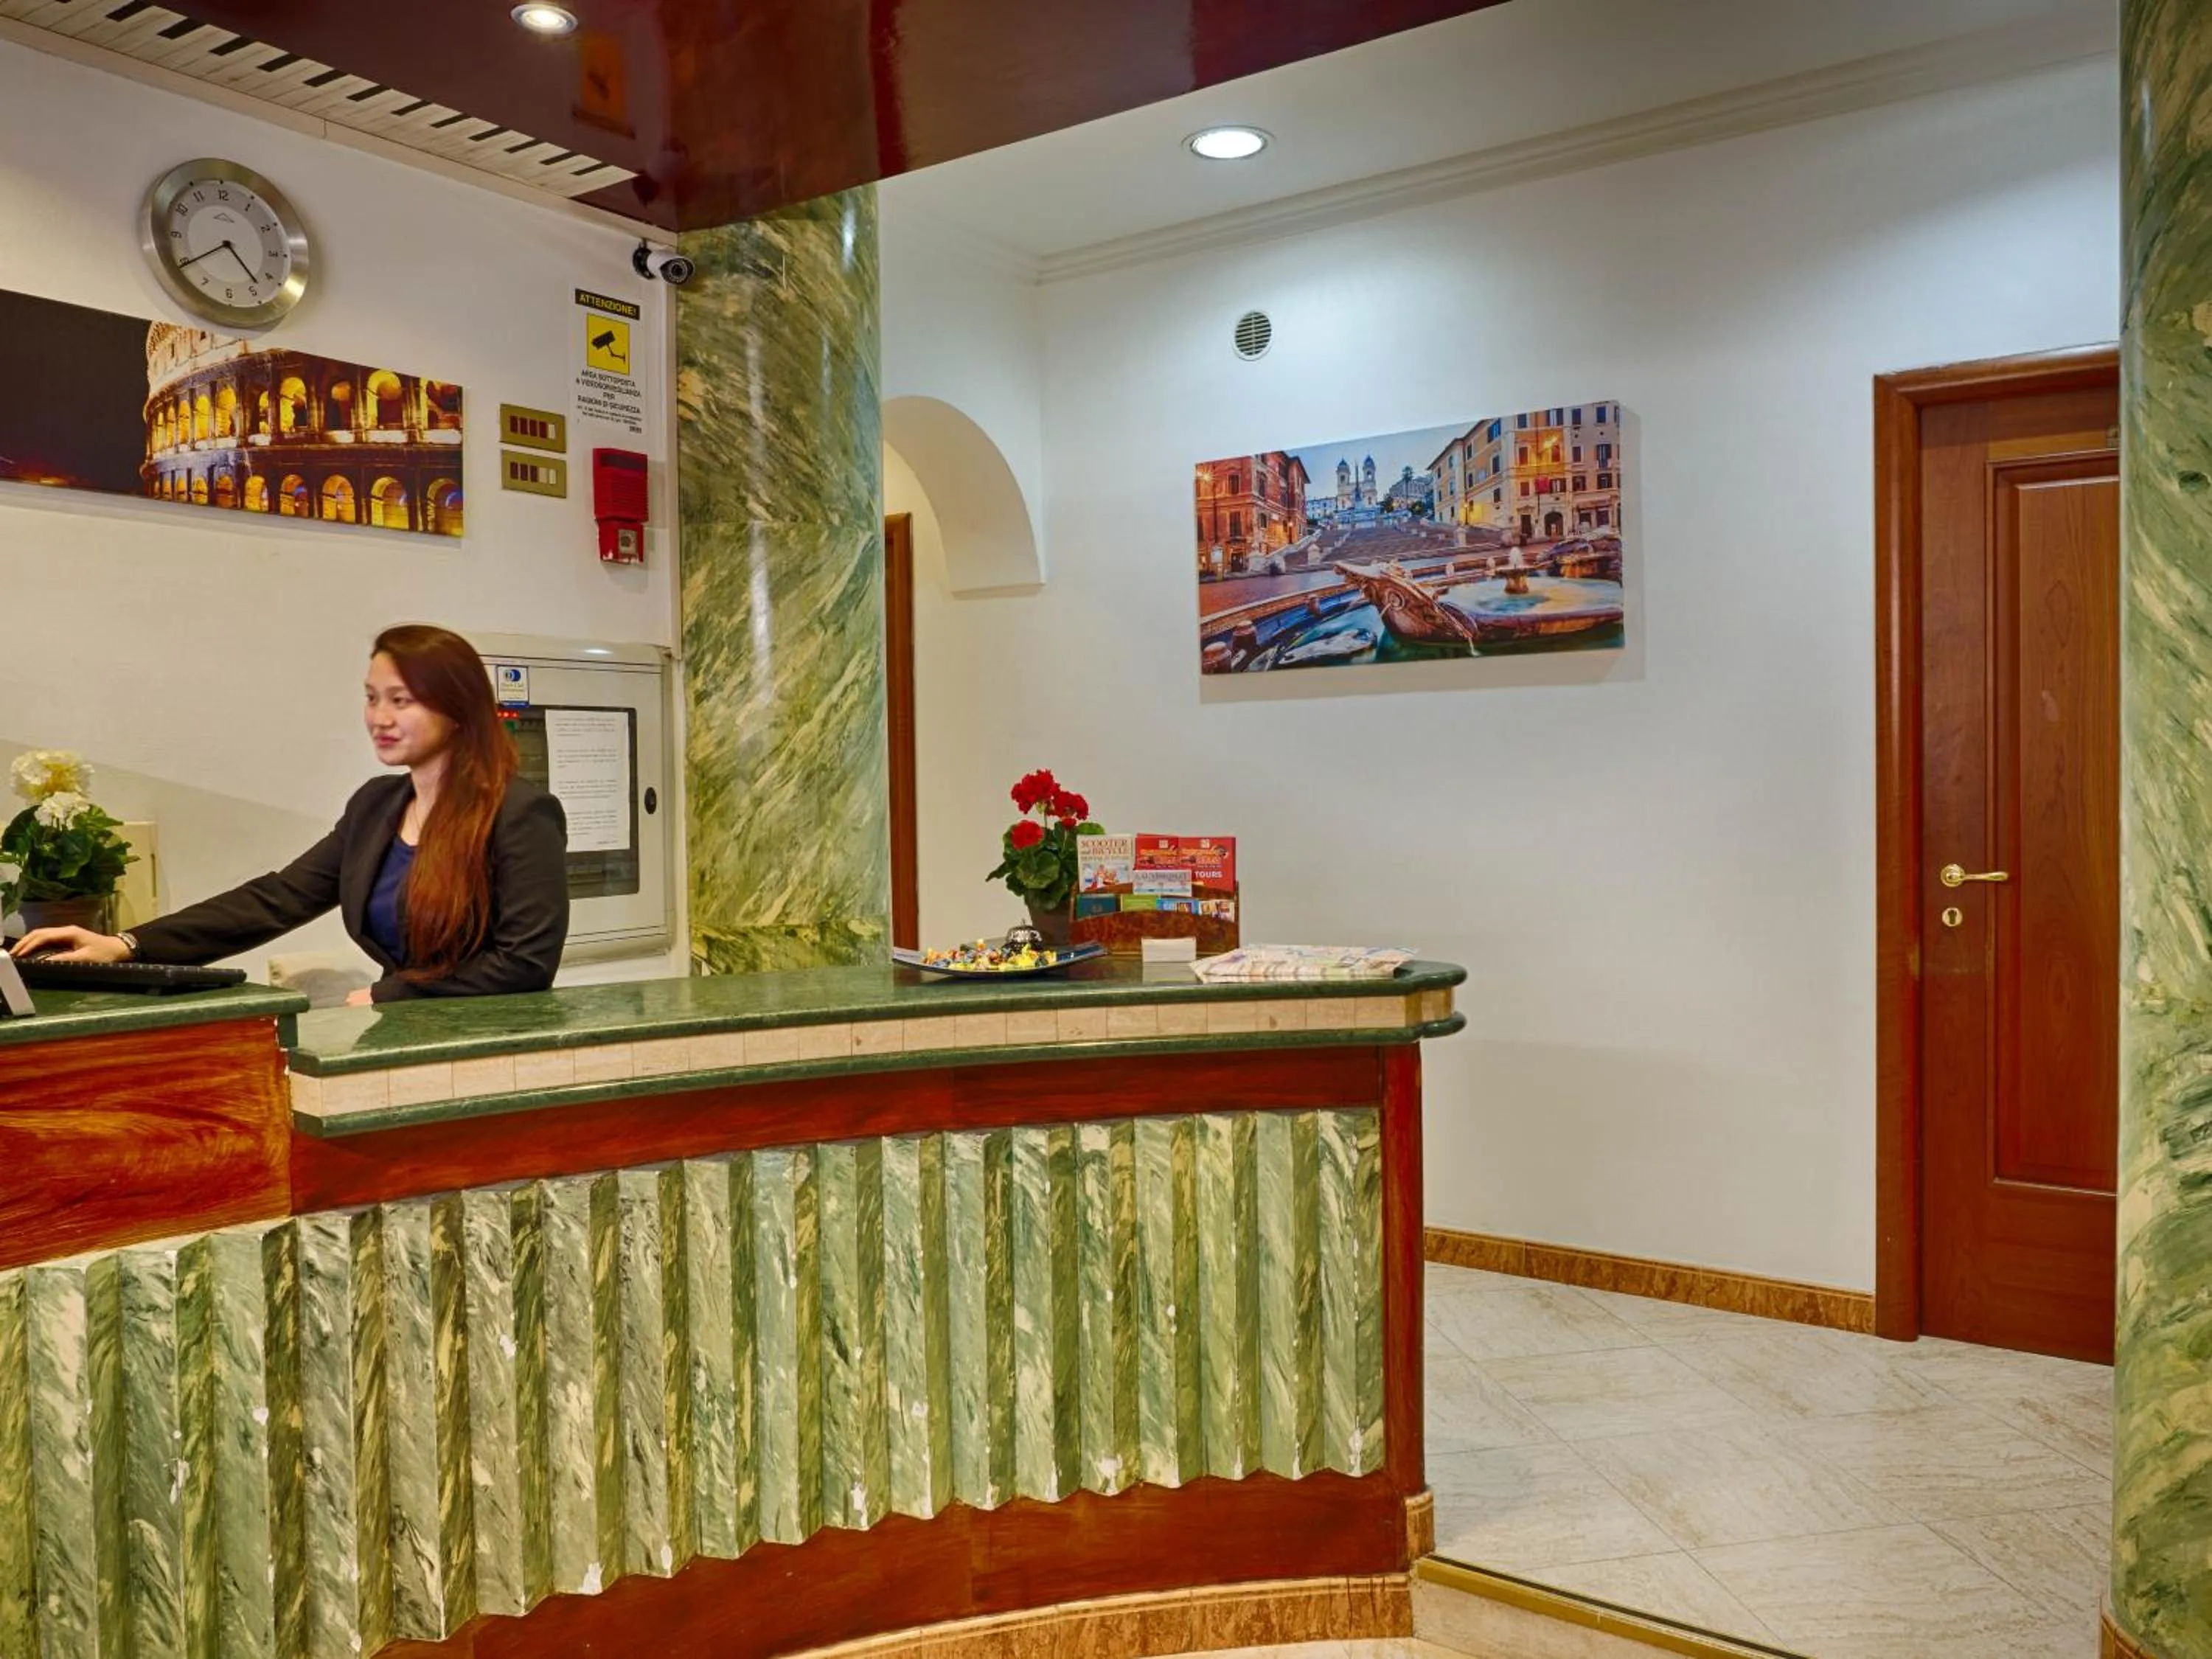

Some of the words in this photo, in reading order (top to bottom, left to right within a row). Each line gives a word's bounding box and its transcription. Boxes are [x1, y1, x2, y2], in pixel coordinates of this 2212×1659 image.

[192, 190, 205, 202] 11
[218, 189, 229, 201] 12
[175, 203, 188, 217] 10
[244, 203, 251, 212] 1
[260, 224, 271, 233] 2
[170, 230, 182, 239] 9
[265, 271, 274, 280] 4
[201, 277, 210, 286] 7
[225, 288, 233, 299] 6
[248, 285, 257, 297] 5
[579, 293, 637, 316] ATTENZIONE!
[602, 392, 616, 400] PER
[1194, 870, 1223, 879] TOURS
